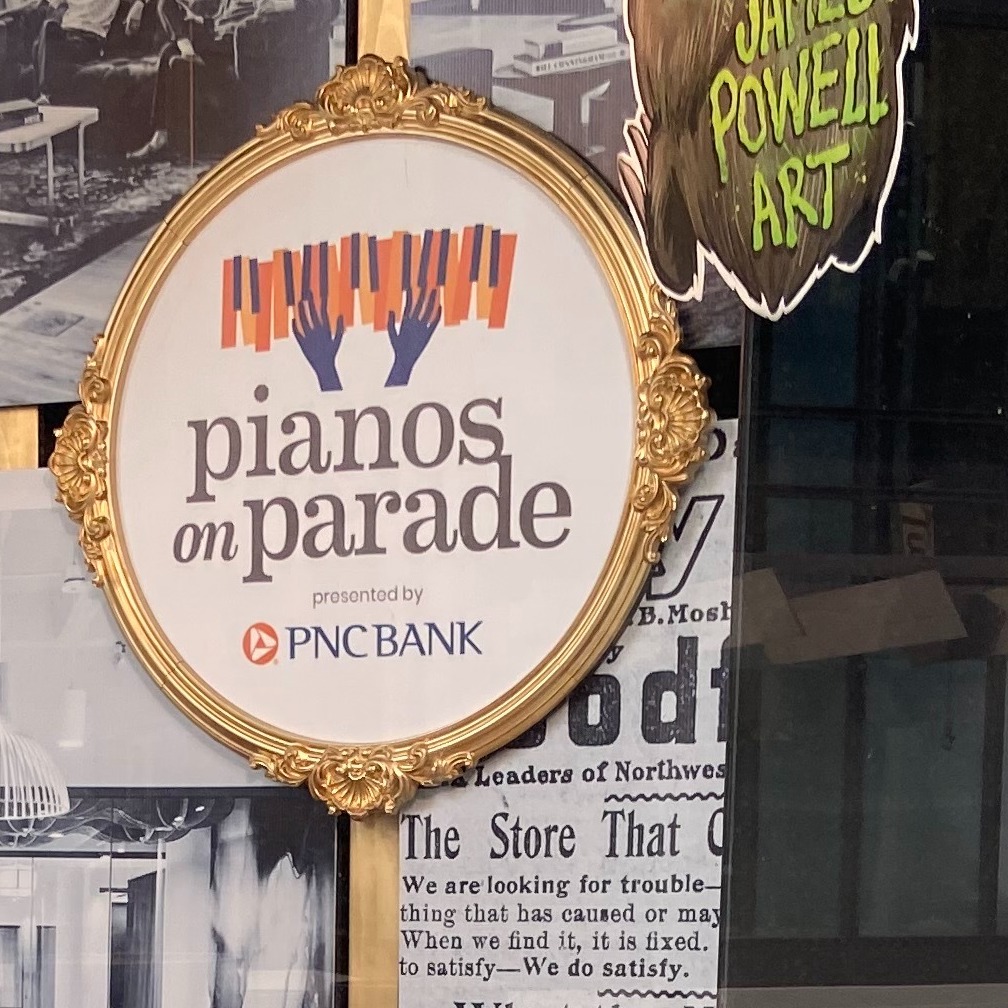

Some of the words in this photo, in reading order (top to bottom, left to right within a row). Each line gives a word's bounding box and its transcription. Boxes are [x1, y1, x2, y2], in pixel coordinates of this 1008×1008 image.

[710, 22, 889, 184] POWELL
[753, 143, 850, 251] ART
[186, 384, 504, 503] pianos
[173, 520, 238, 563] on
[242, 454, 572, 583] parade
[312, 586, 398, 609] presented
[402, 585, 424, 605] by
[376, 621, 484, 657] BANK
[474, 765, 573, 787] Leaders
[582, 761, 607, 782] of
[401, 813, 460, 860] The
[490, 811, 576, 859] Store
[601, 809, 681, 857] That
[402, 876, 438, 894] We
[445, 877, 480, 894] are
[487, 875, 570, 898] looking
[580, 875, 611, 894] for
[400, 904, 456, 928] thing
[465, 904, 508, 922] that
[517, 904, 553, 922] has
[561, 903, 635, 922] caused
[645, 907, 667, 922] or
[678, 907, 721, 928] may
[401, 930, 462, 949] When
[472, 935, 500, 949] we
[508, 931, 548, 949] find
[558, 931, 582, 954] it,
[592, 931, 609, 949] it
[619, 931, 636, 949] is
[645, 930, 708, 951] fixed.
[398, 958, 419, 976] to
[568, 958, 593, 977] do
[602, 958, 690, 982] satisfy.
